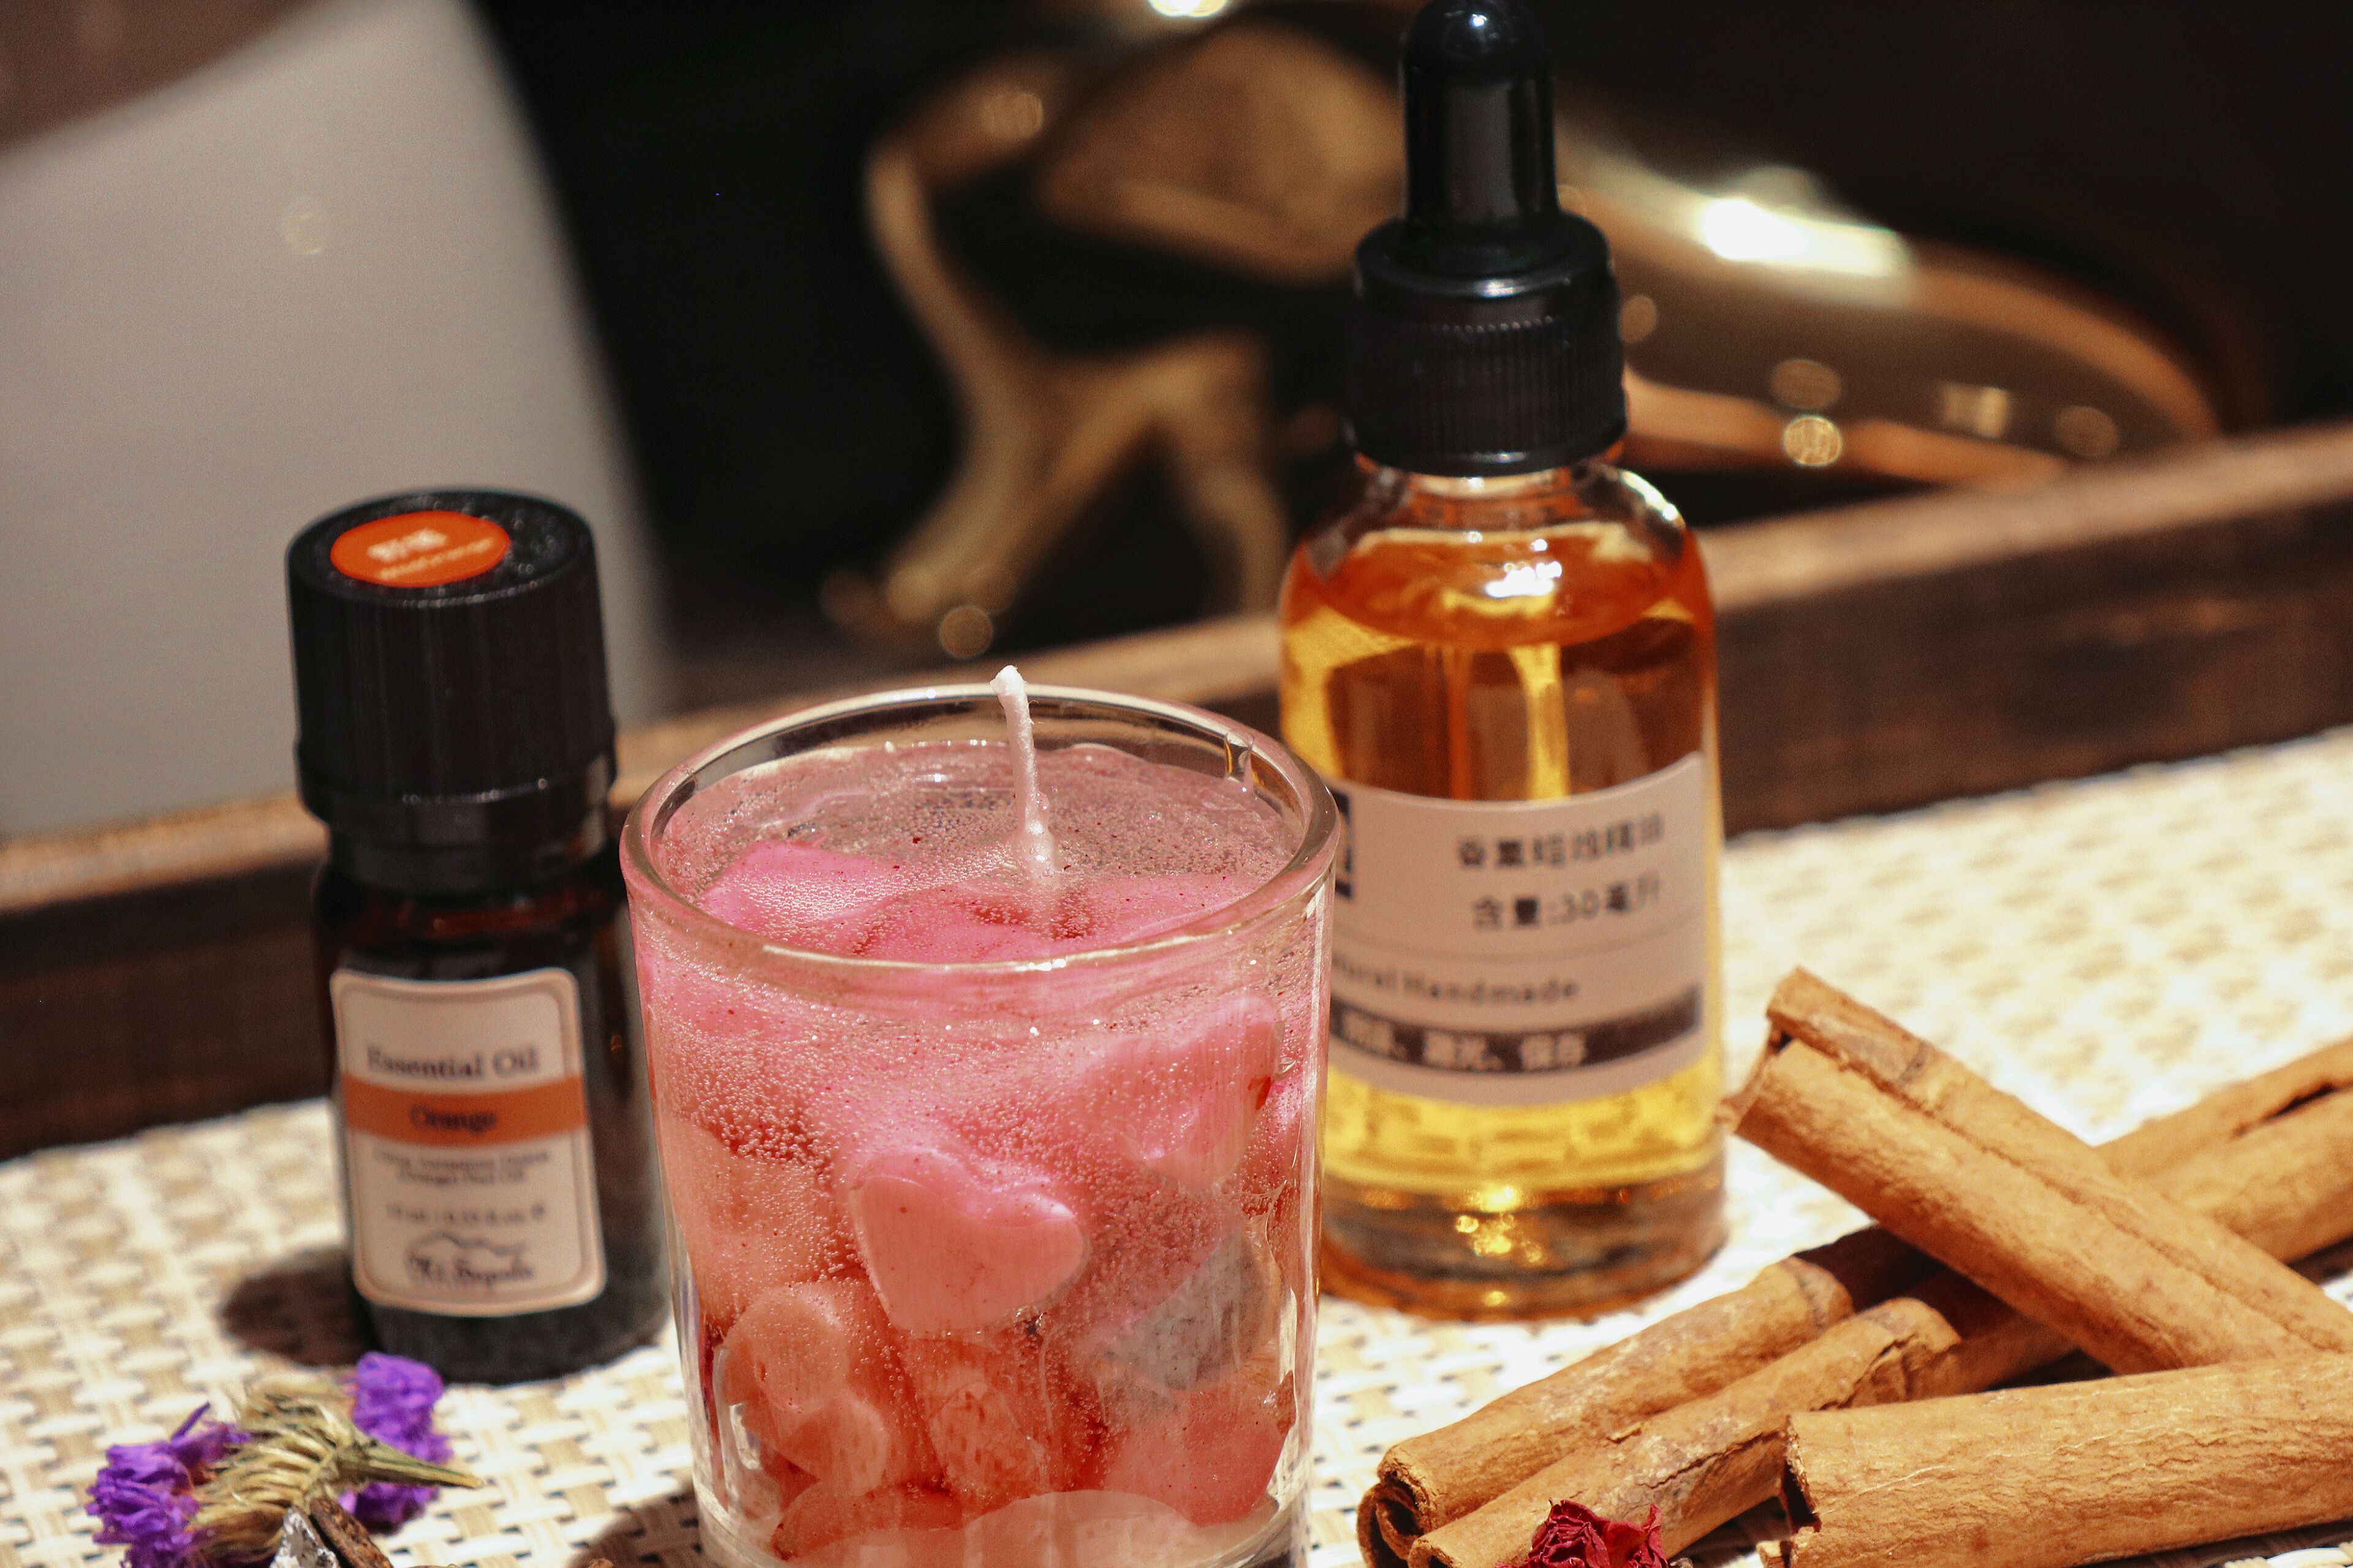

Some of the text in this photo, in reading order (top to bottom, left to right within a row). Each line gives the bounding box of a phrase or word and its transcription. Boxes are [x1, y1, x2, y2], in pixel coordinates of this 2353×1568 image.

[1403, 971, 1580, 1006] Handmade
[367, 1048, 537, 1078] Essential Oil
[409, 1105, 497, 1135] Orange
